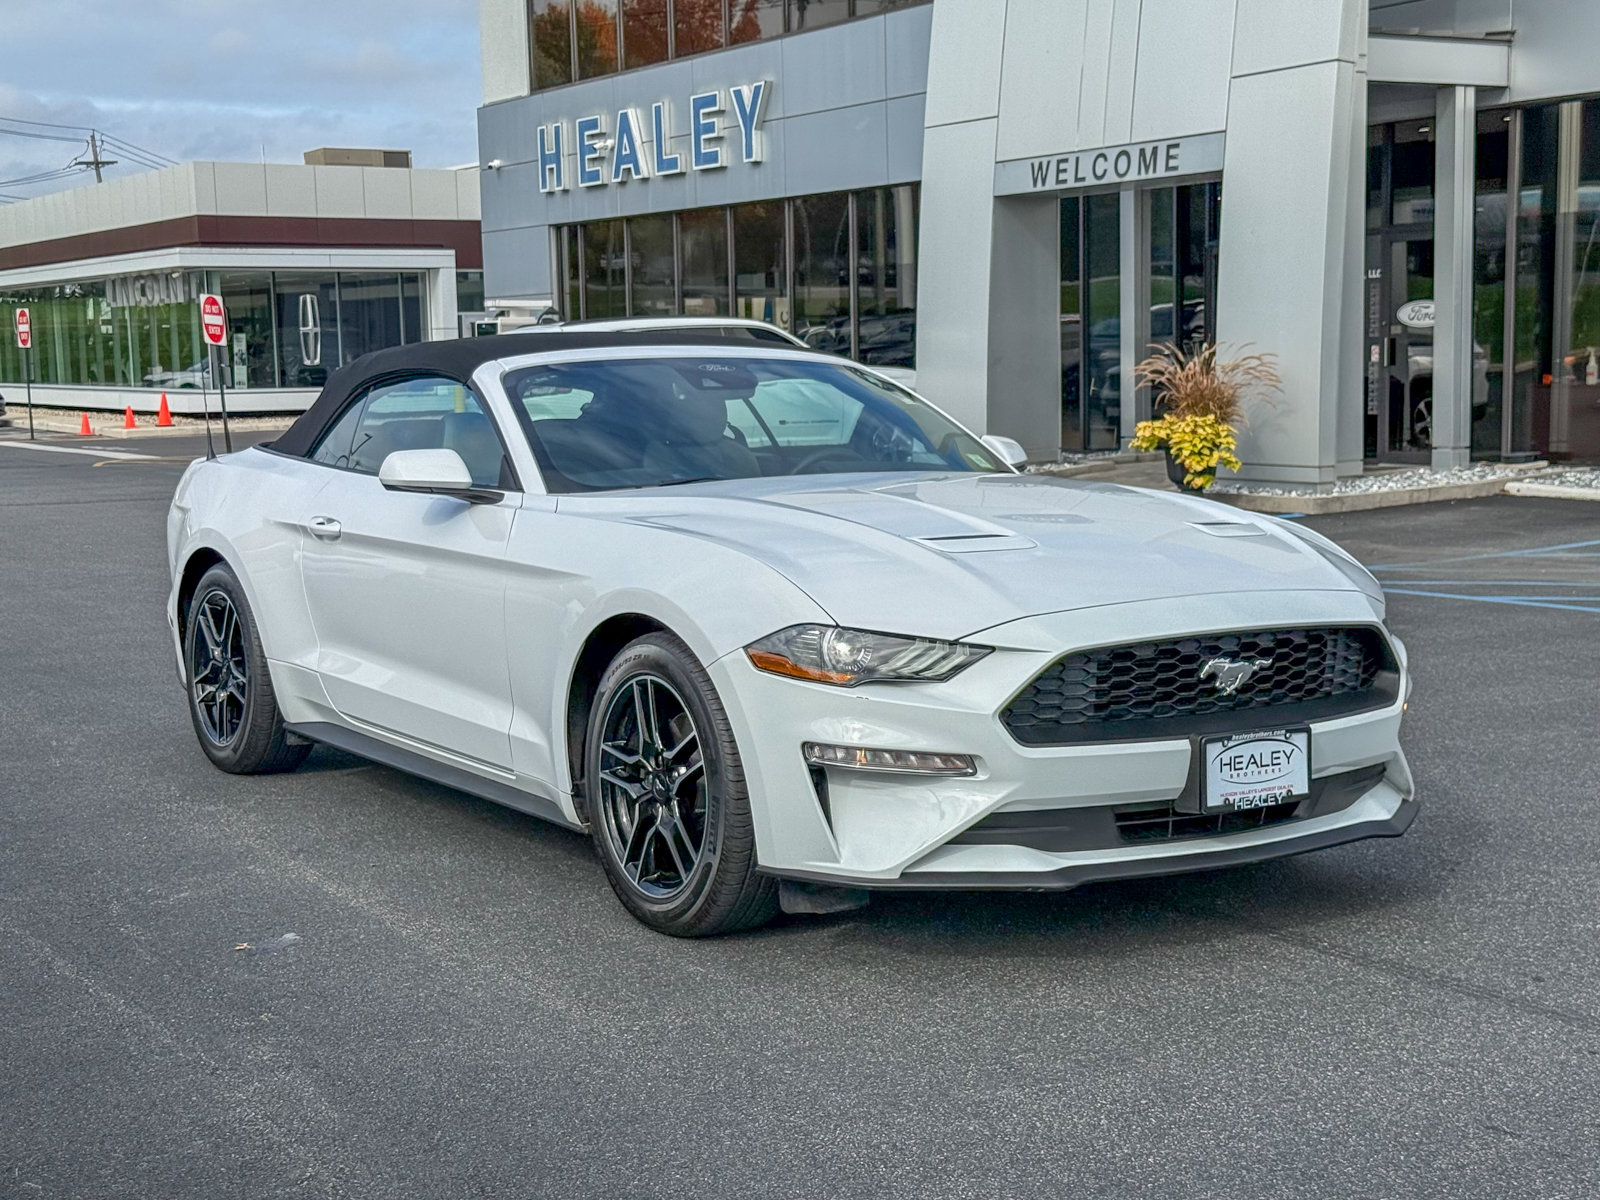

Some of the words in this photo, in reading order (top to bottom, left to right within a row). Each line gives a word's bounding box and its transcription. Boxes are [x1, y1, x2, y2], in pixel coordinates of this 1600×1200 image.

[537, 79, 772, 193] HEALEY
[1031, 143, 1181, 188] WELCOME
[204, 304, 211, 313] DO
[211, 305, 220, 314] NOT
[208, 325, 222, 336] ENTER
[1220, 748, 1295, 773] HEALEY
[1230, 768, 1282, 779] BROTHERS
[1234, 792, 1283, 810] HEALEY
